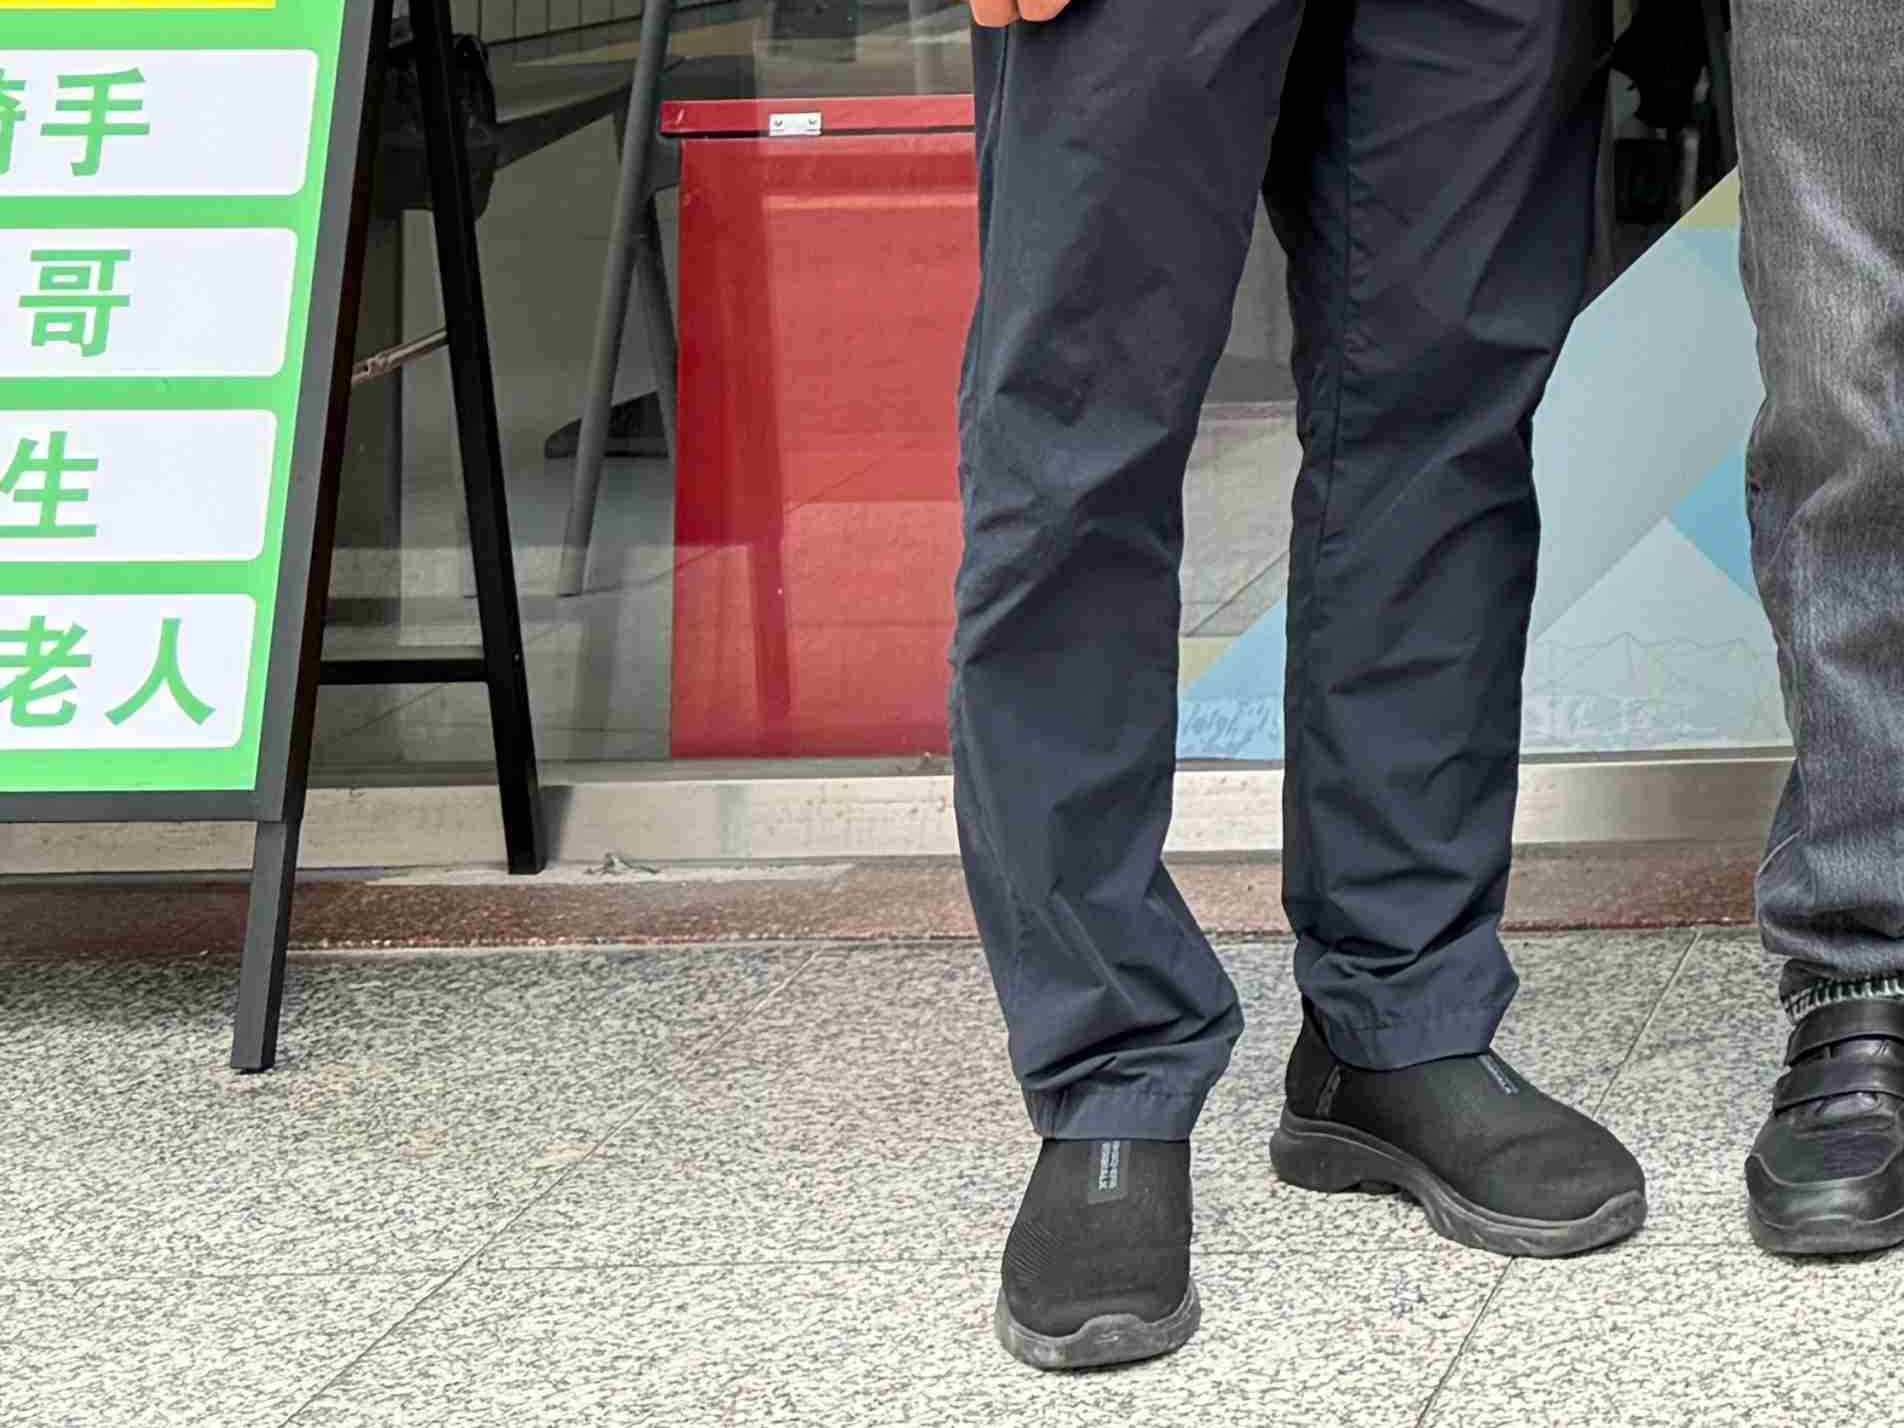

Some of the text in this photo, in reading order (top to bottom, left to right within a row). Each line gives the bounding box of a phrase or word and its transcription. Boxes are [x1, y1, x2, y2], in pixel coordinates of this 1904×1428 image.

[0, 66, 151, 177] 手
[18, 248, 132, 357] 哥
[0, 429, 98, 540] 生
[0, 615, 215, 727] 老人
